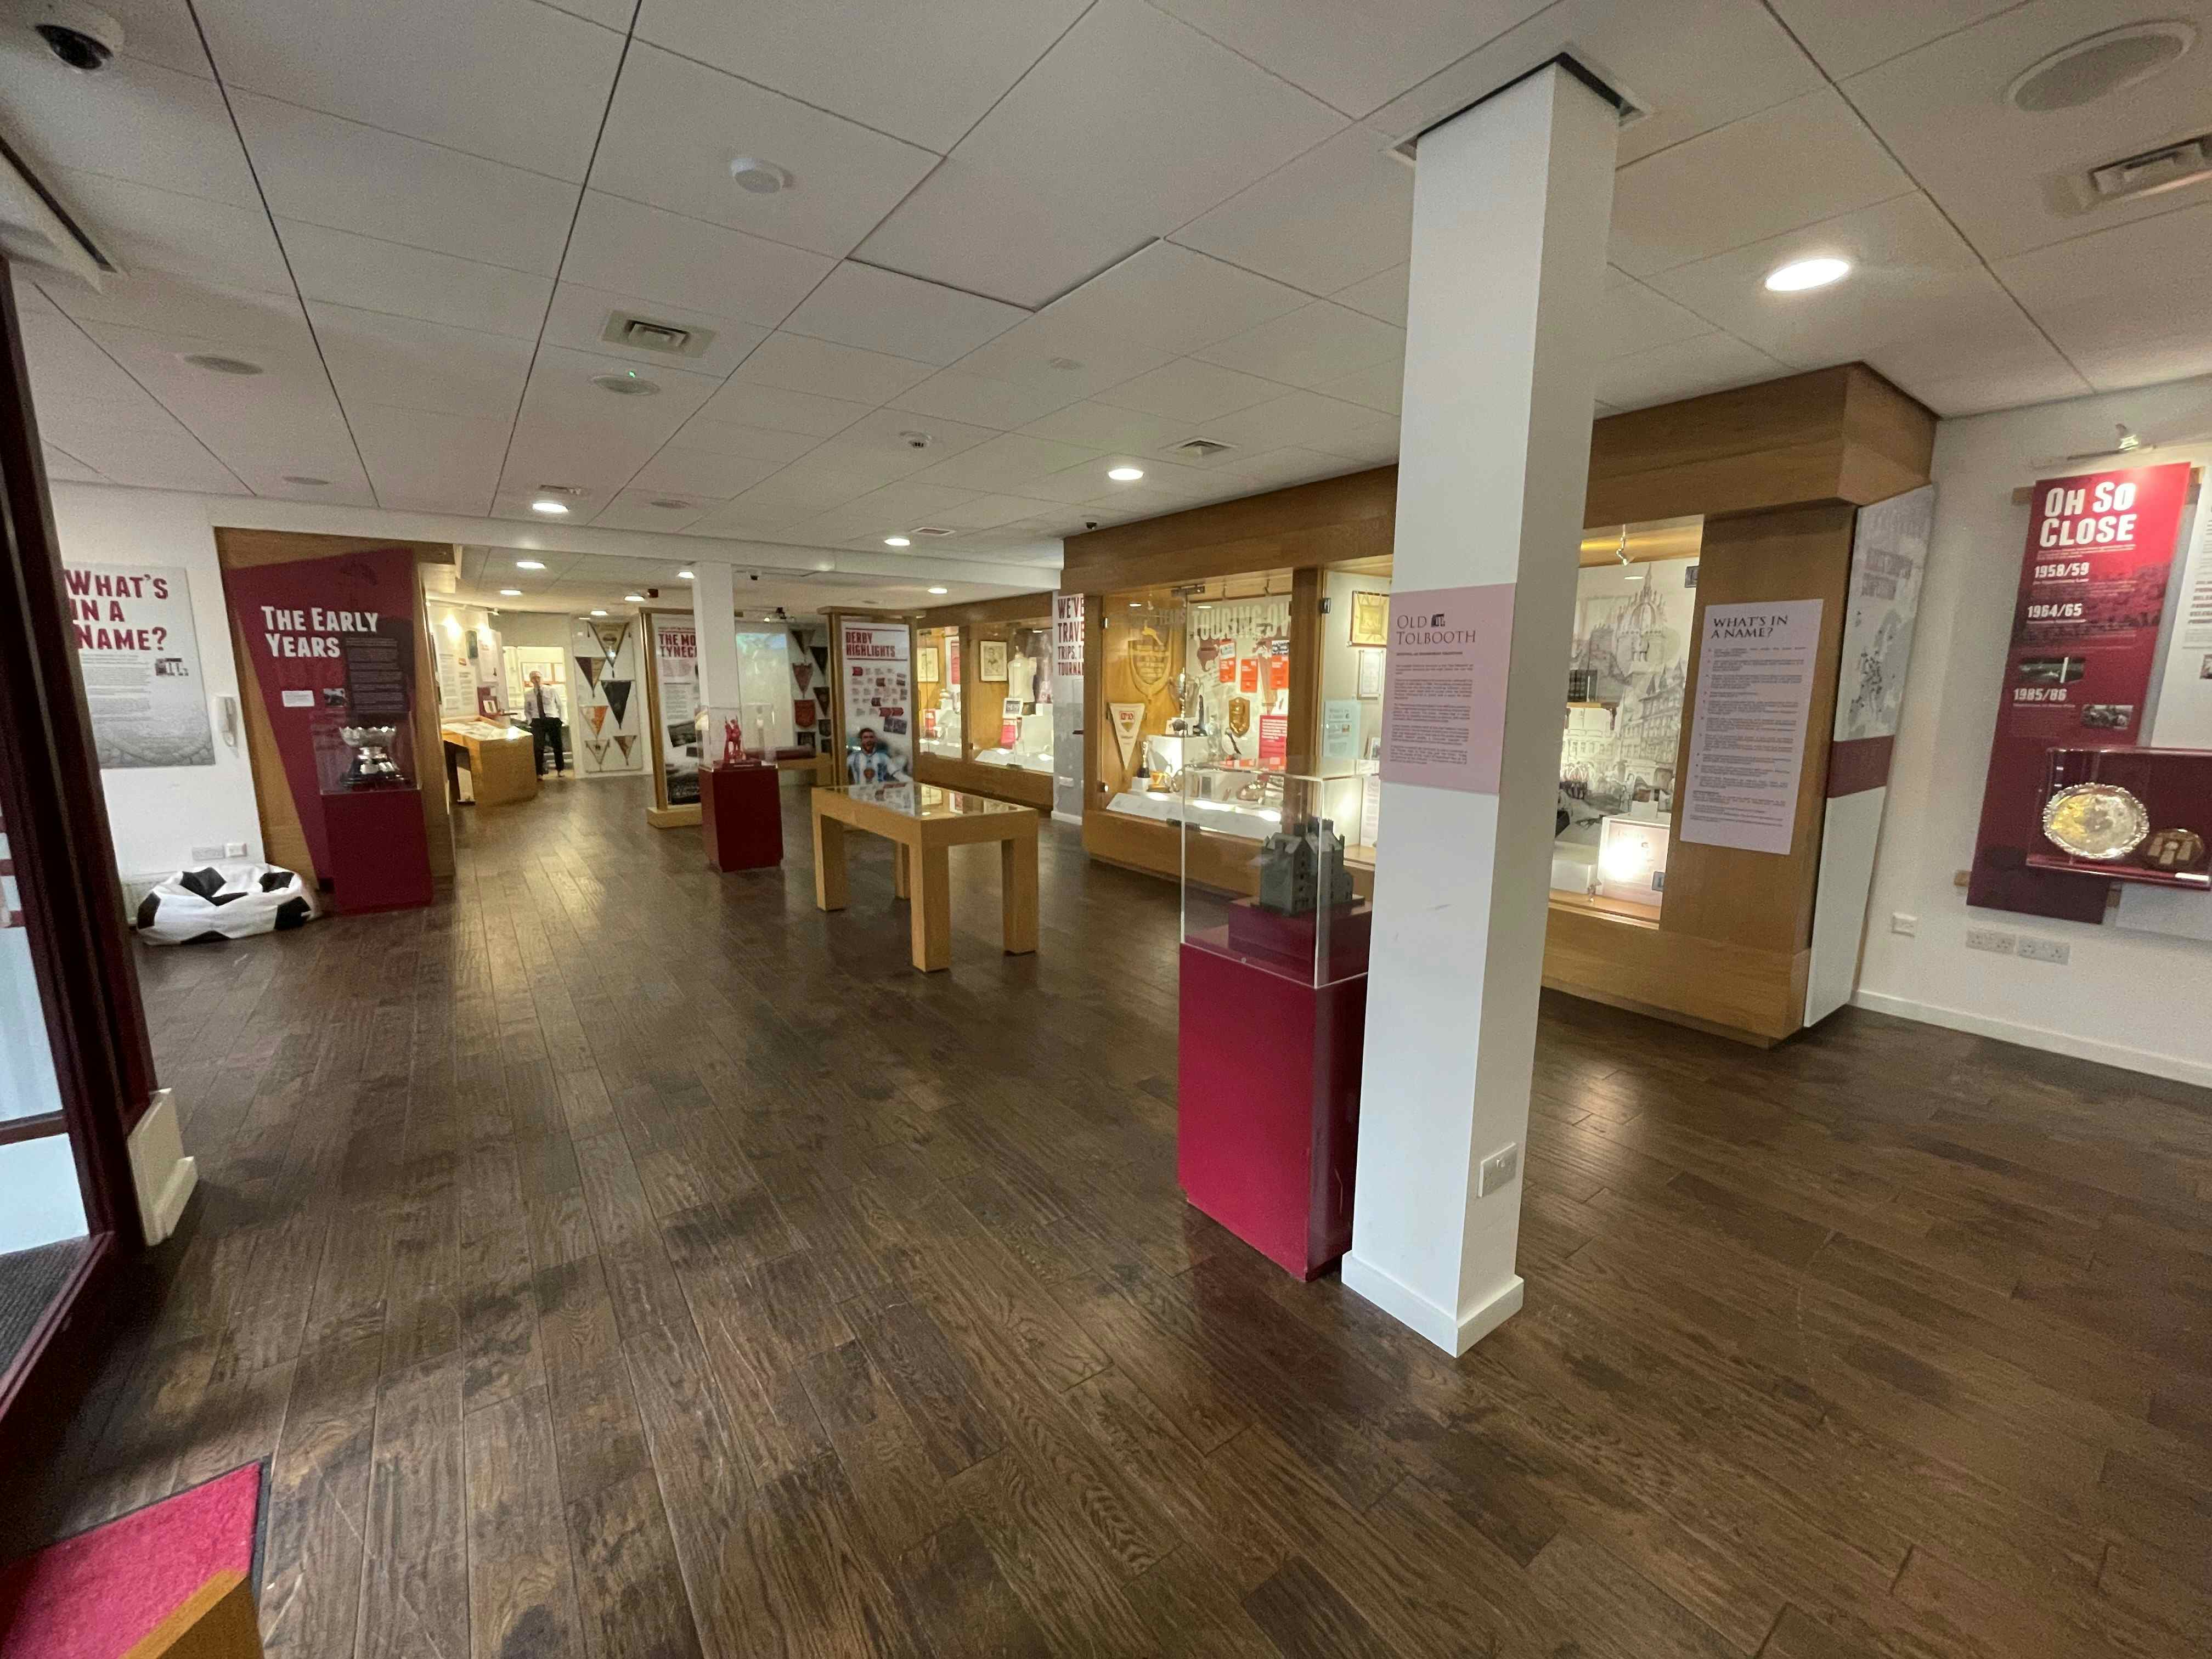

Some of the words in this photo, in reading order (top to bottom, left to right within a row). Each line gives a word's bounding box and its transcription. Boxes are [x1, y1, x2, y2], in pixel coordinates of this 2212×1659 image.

[2045, 488, 2086, 517] OH
[2092, 482, 2136, 512] SO
[2039, 514, 2137, 547] CLOSE
[2034, 562, 2090, 578] 1958/59
[63, 569, 168, 599] WHAT'S
[70, 599, 100, 621] IN
[110, 601, 125, 622] A
[2027, 603, 2083, 618] 1964/65
[261, 606, 307, 631] THE
[311, 607, 378, 632] EARLY
[1397, 614, 1427, 629] OLD
[1713, 617, 1766, 627] WHAT'S
[1770, 614, 1788, 626] IN
[72, 624, 167, 651] NAME?
[658, 634, 679, 645] THE
[845, 631, 873, 644] DERBY
[1397, 630, 1476, 645] TOLBOOTH
[1711, 629, 1720, 639] A
[1724, 627, 1773, 639] NAME?
[265, 633, 341, 657] YEARS
[660, 646, 697, 658] TYNEC
[846, 644, 896, 657] HIGHLIGHTS
